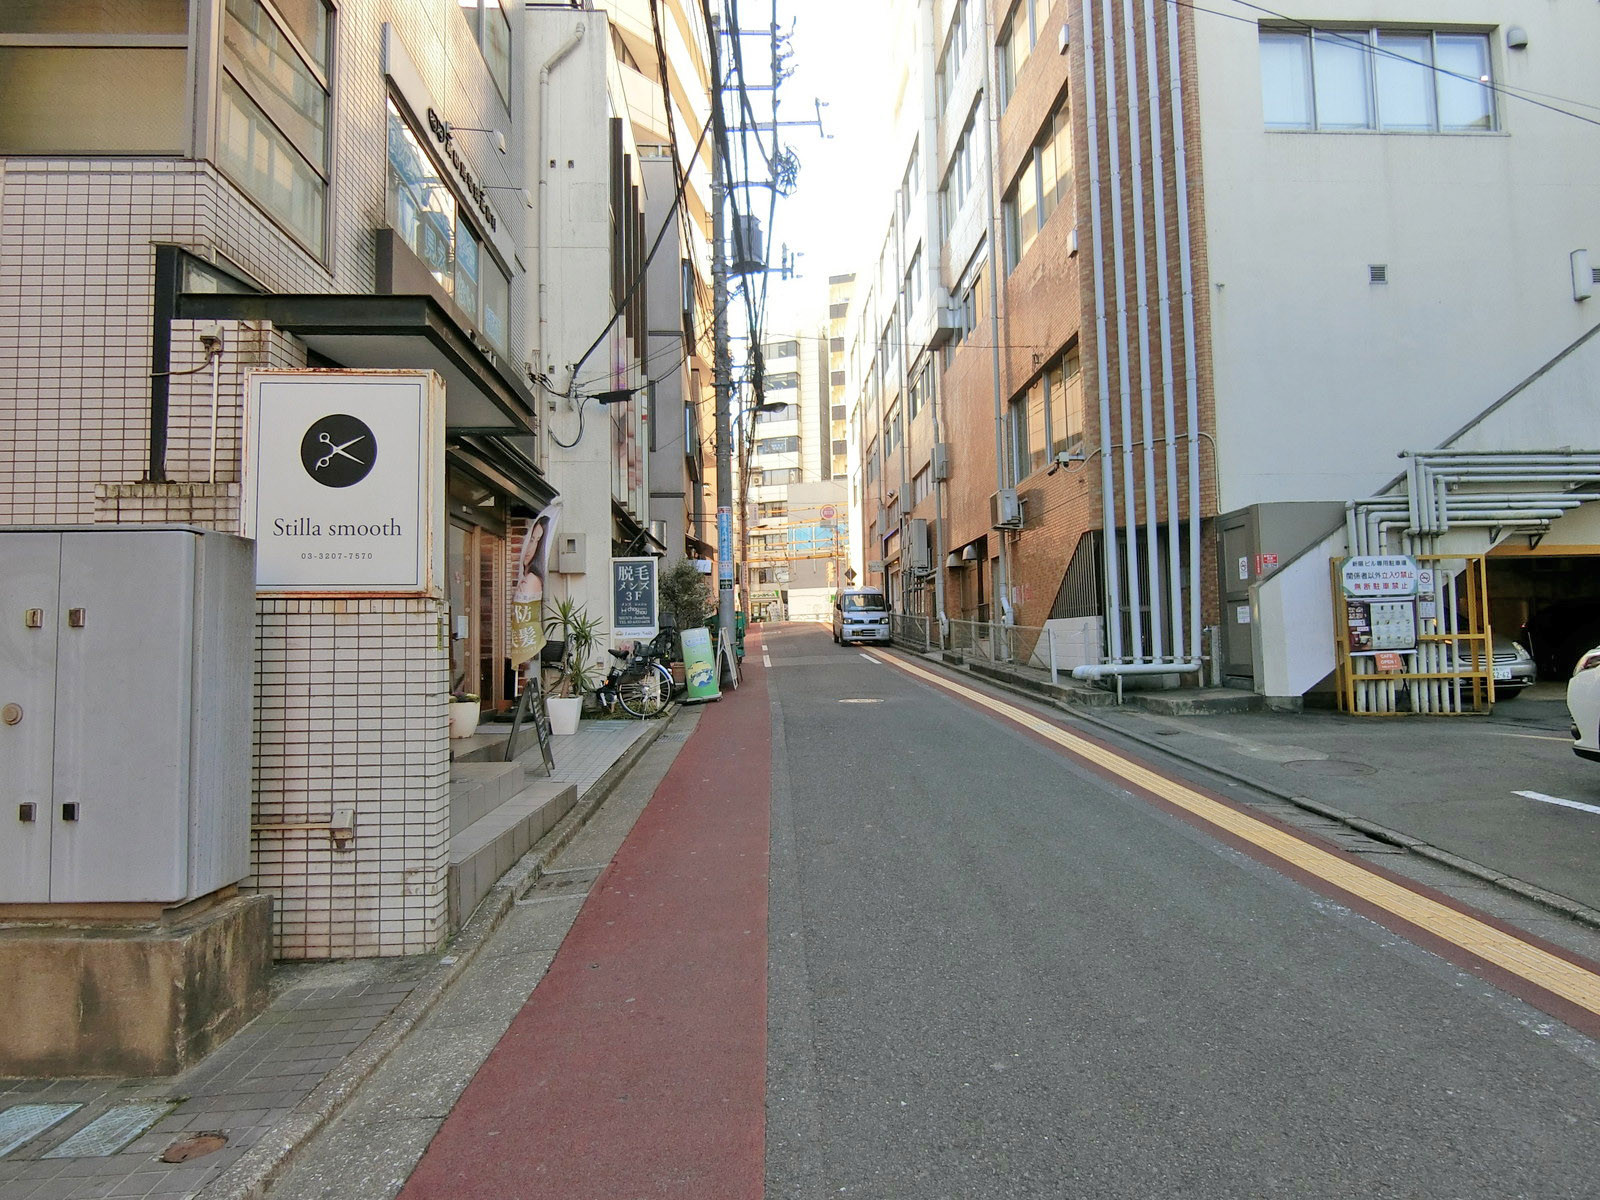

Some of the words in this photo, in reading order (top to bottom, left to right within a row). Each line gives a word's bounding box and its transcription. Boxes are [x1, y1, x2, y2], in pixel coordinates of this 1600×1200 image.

[272, 517, 323, 537] Stilla
[328, 517, 403, 537] smooth
[300, 552, 374, 561] 03-3207-7570
[618, 565, 650, 581] 脱毛
[1346, 571, 1414, 580] 関係者以外立入り禁止
[618, 581, 650, 592] メンズ
[1354, 582, 1409, 591] 無断駐車禁止
